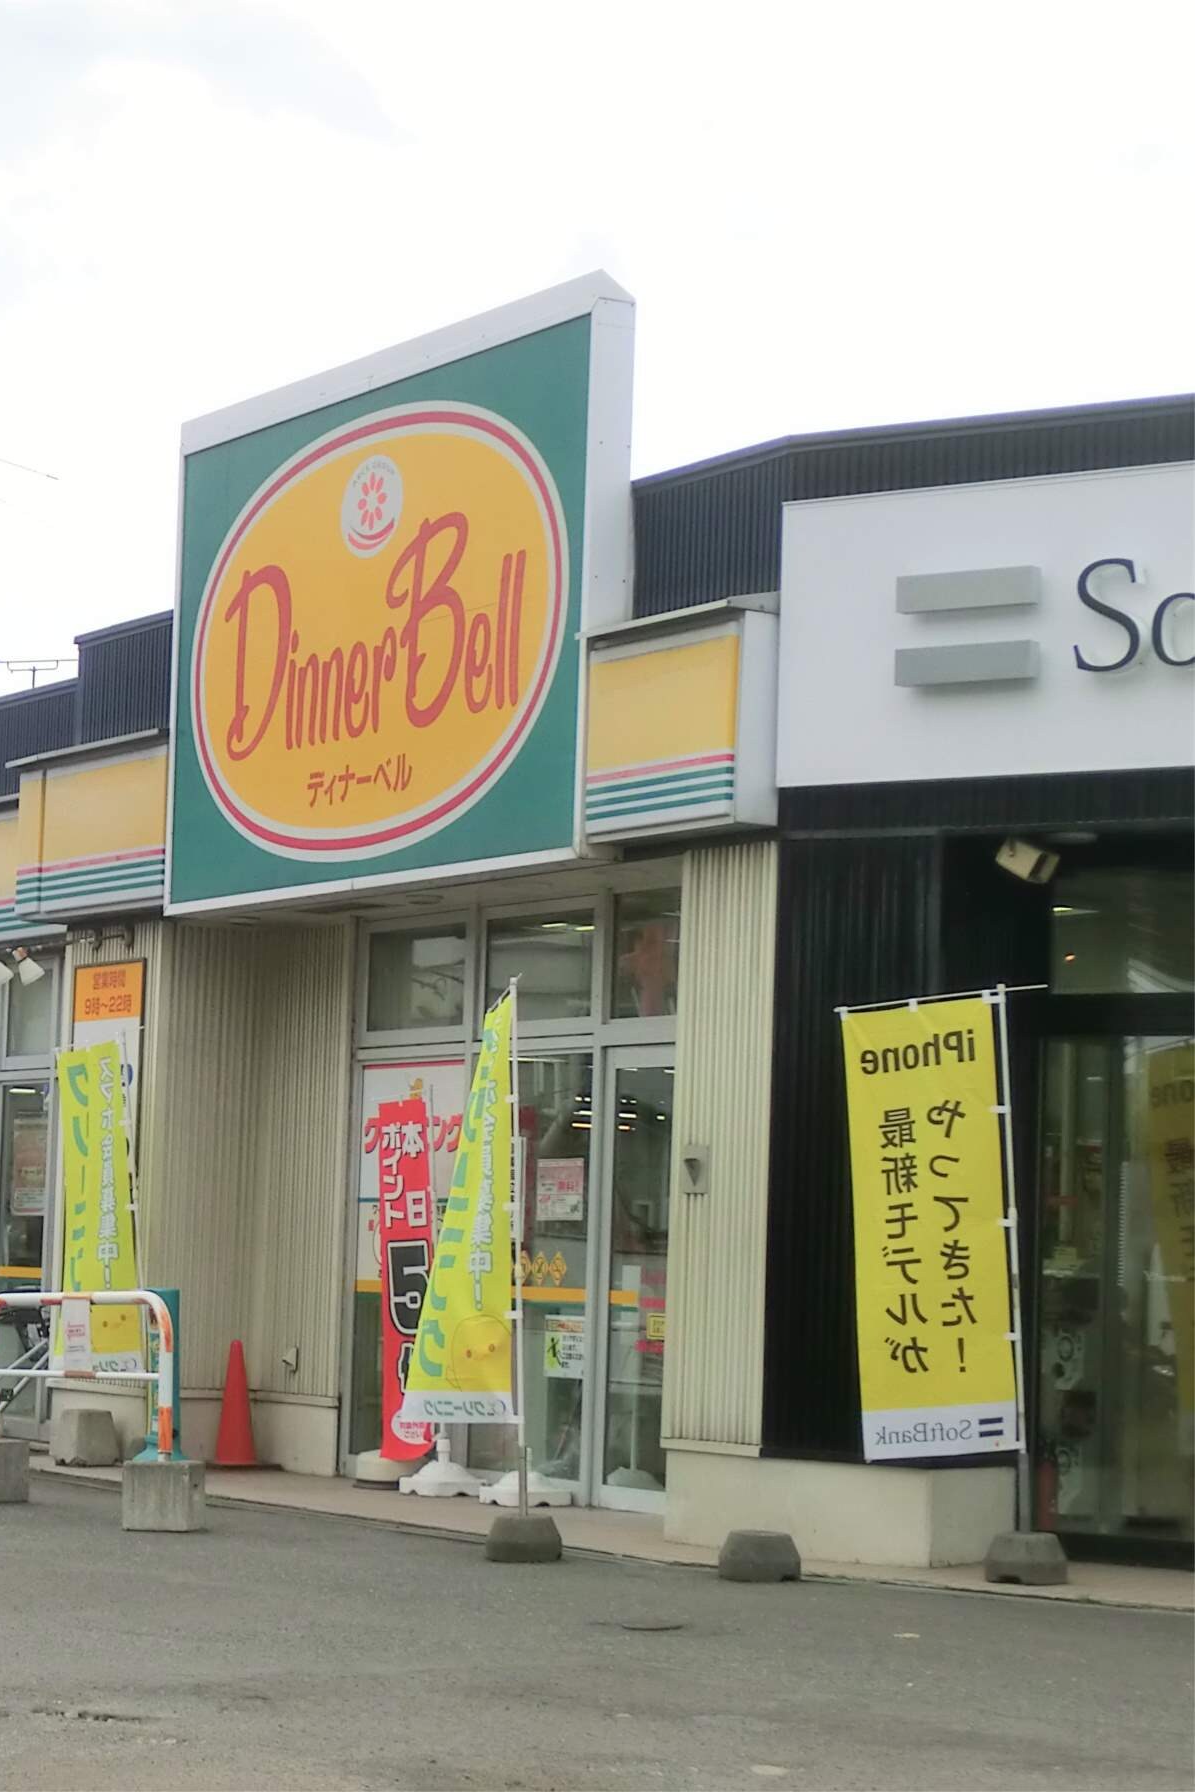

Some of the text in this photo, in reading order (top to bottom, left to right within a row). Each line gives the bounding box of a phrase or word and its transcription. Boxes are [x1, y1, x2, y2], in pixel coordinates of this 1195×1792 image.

[225, 512, 527, 761] Dinner Bell
[381, 1122, 405, 1228] ポイント
[401, 1121, 427, 1227] 本日
